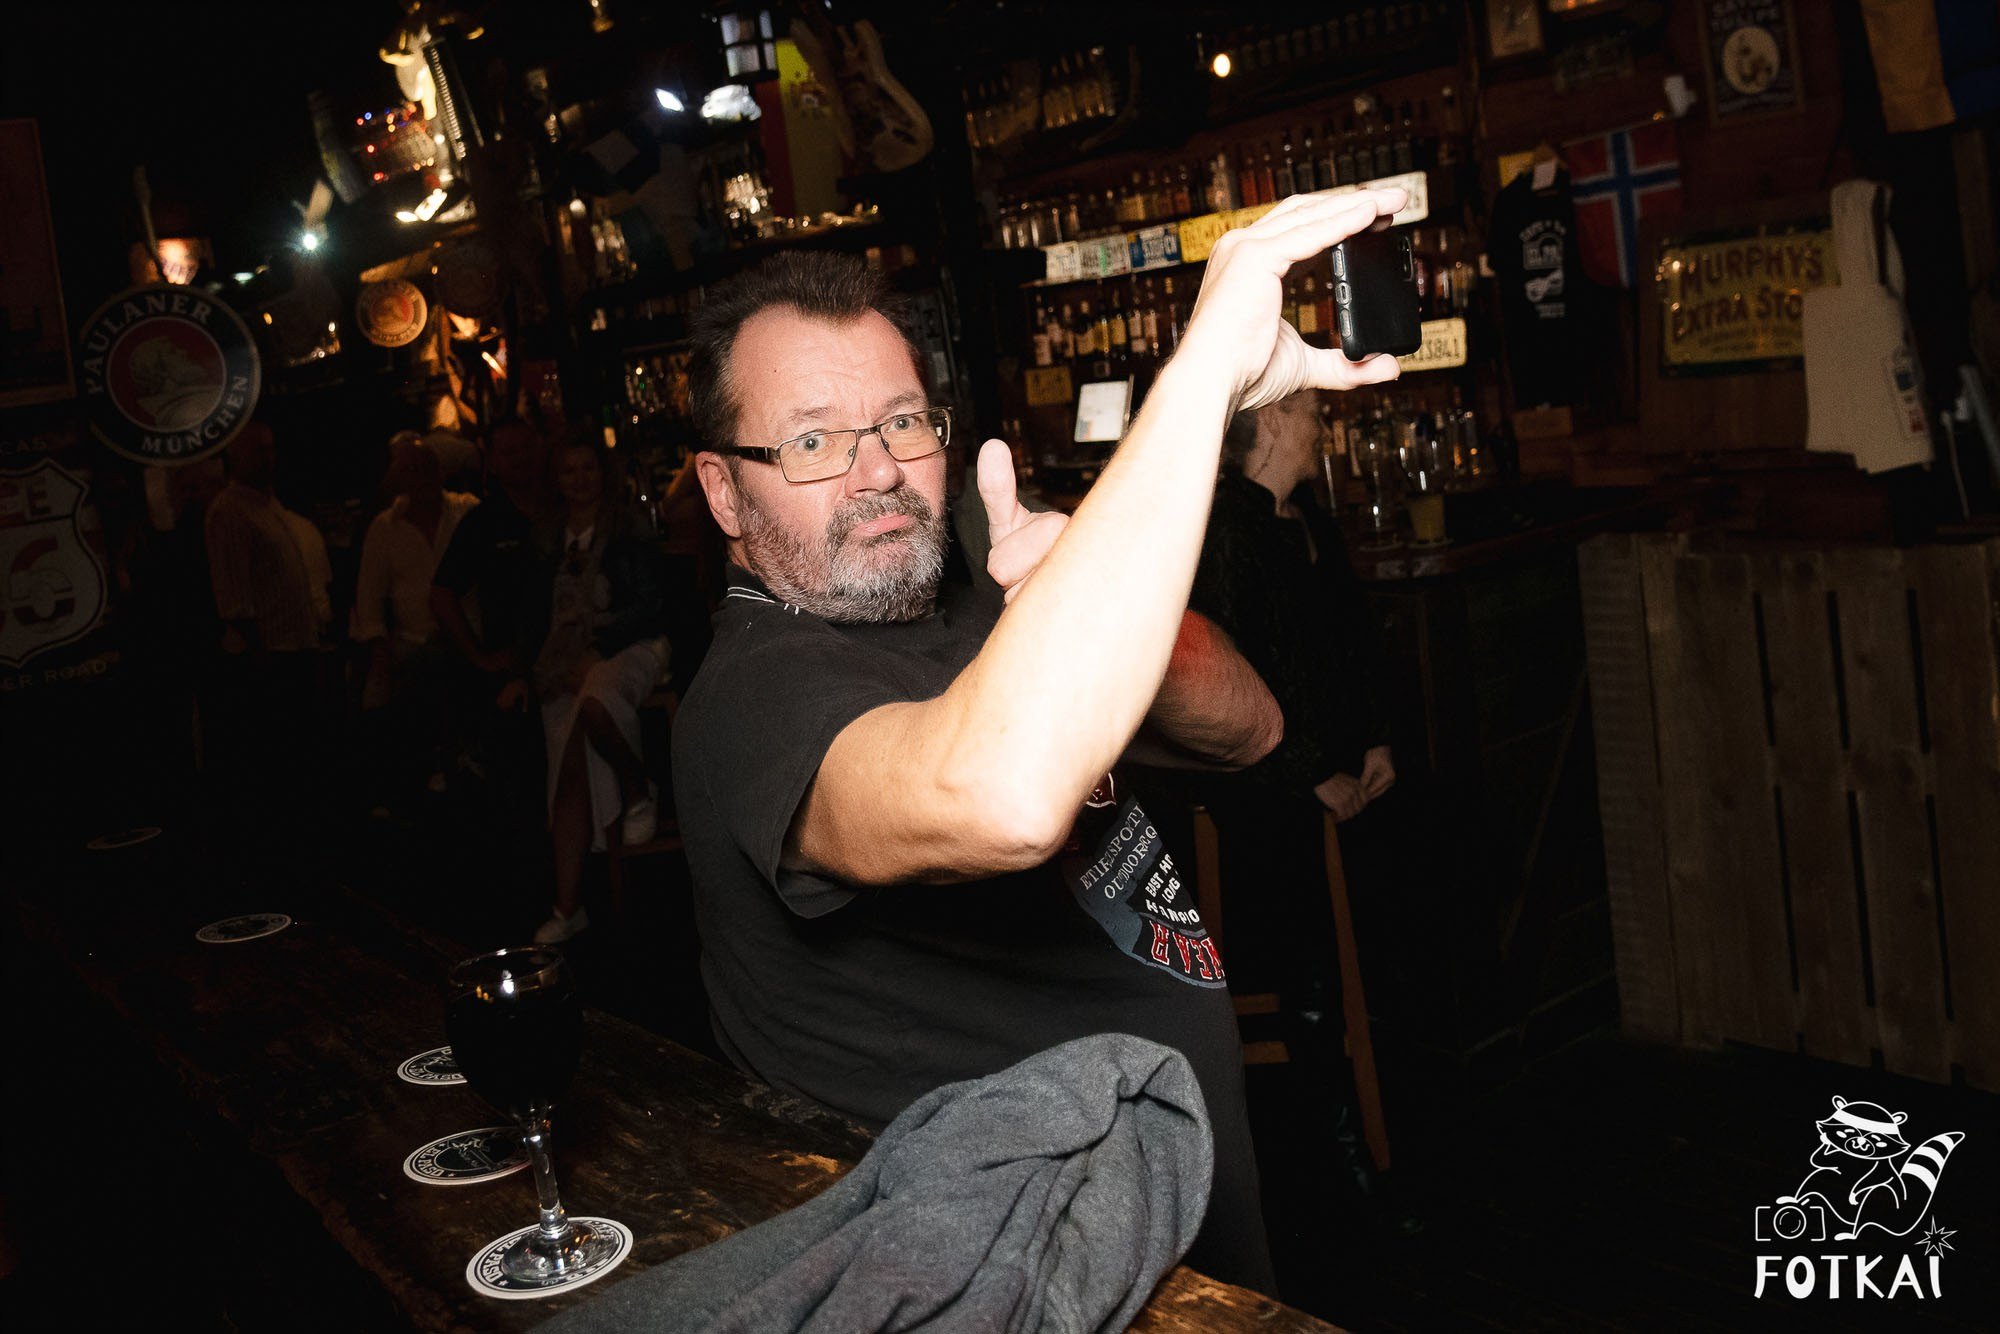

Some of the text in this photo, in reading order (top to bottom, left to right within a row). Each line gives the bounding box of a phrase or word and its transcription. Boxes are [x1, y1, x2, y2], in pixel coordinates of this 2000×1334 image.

[1678, 247, 1823, 299] MURPHY'S
[1672, 296, 1748, 342] EXTRA
[1757, 285, 1803, 321] STO
[83, 293, 213, 395] PAULANER
[1144, 872, 1165, 898] EAST
[483, 1249, 506, 1284] PASO
